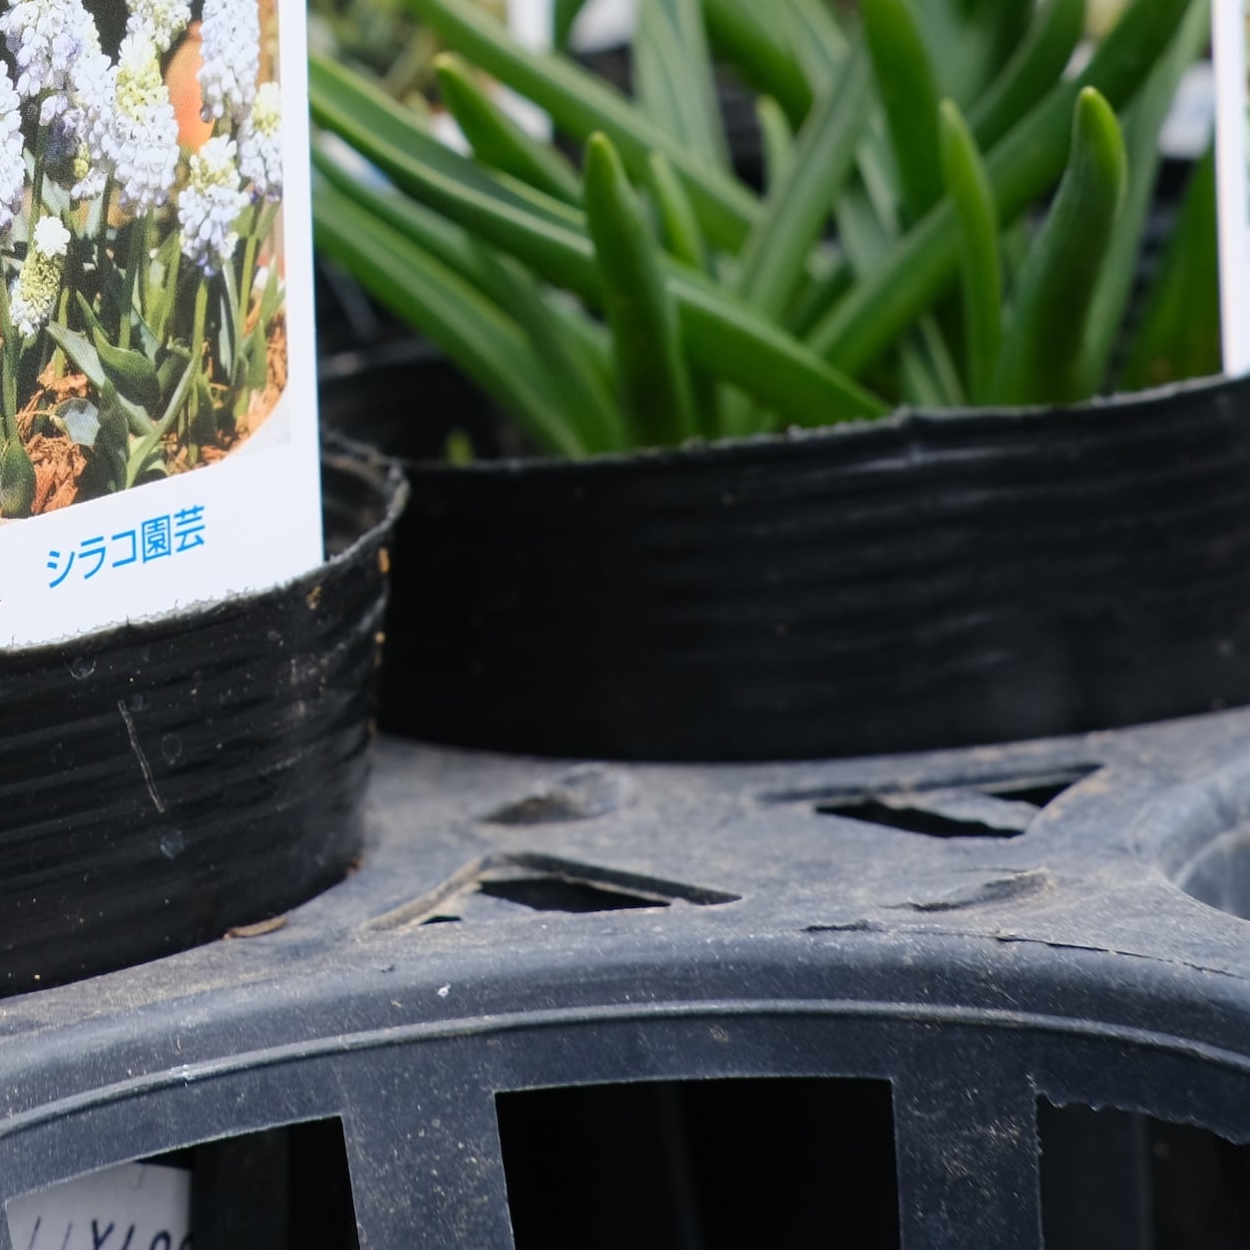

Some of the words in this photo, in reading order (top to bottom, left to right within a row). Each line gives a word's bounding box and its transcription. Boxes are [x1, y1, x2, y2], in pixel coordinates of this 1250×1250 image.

[46, 504, 206, 589] シラコ園芸
